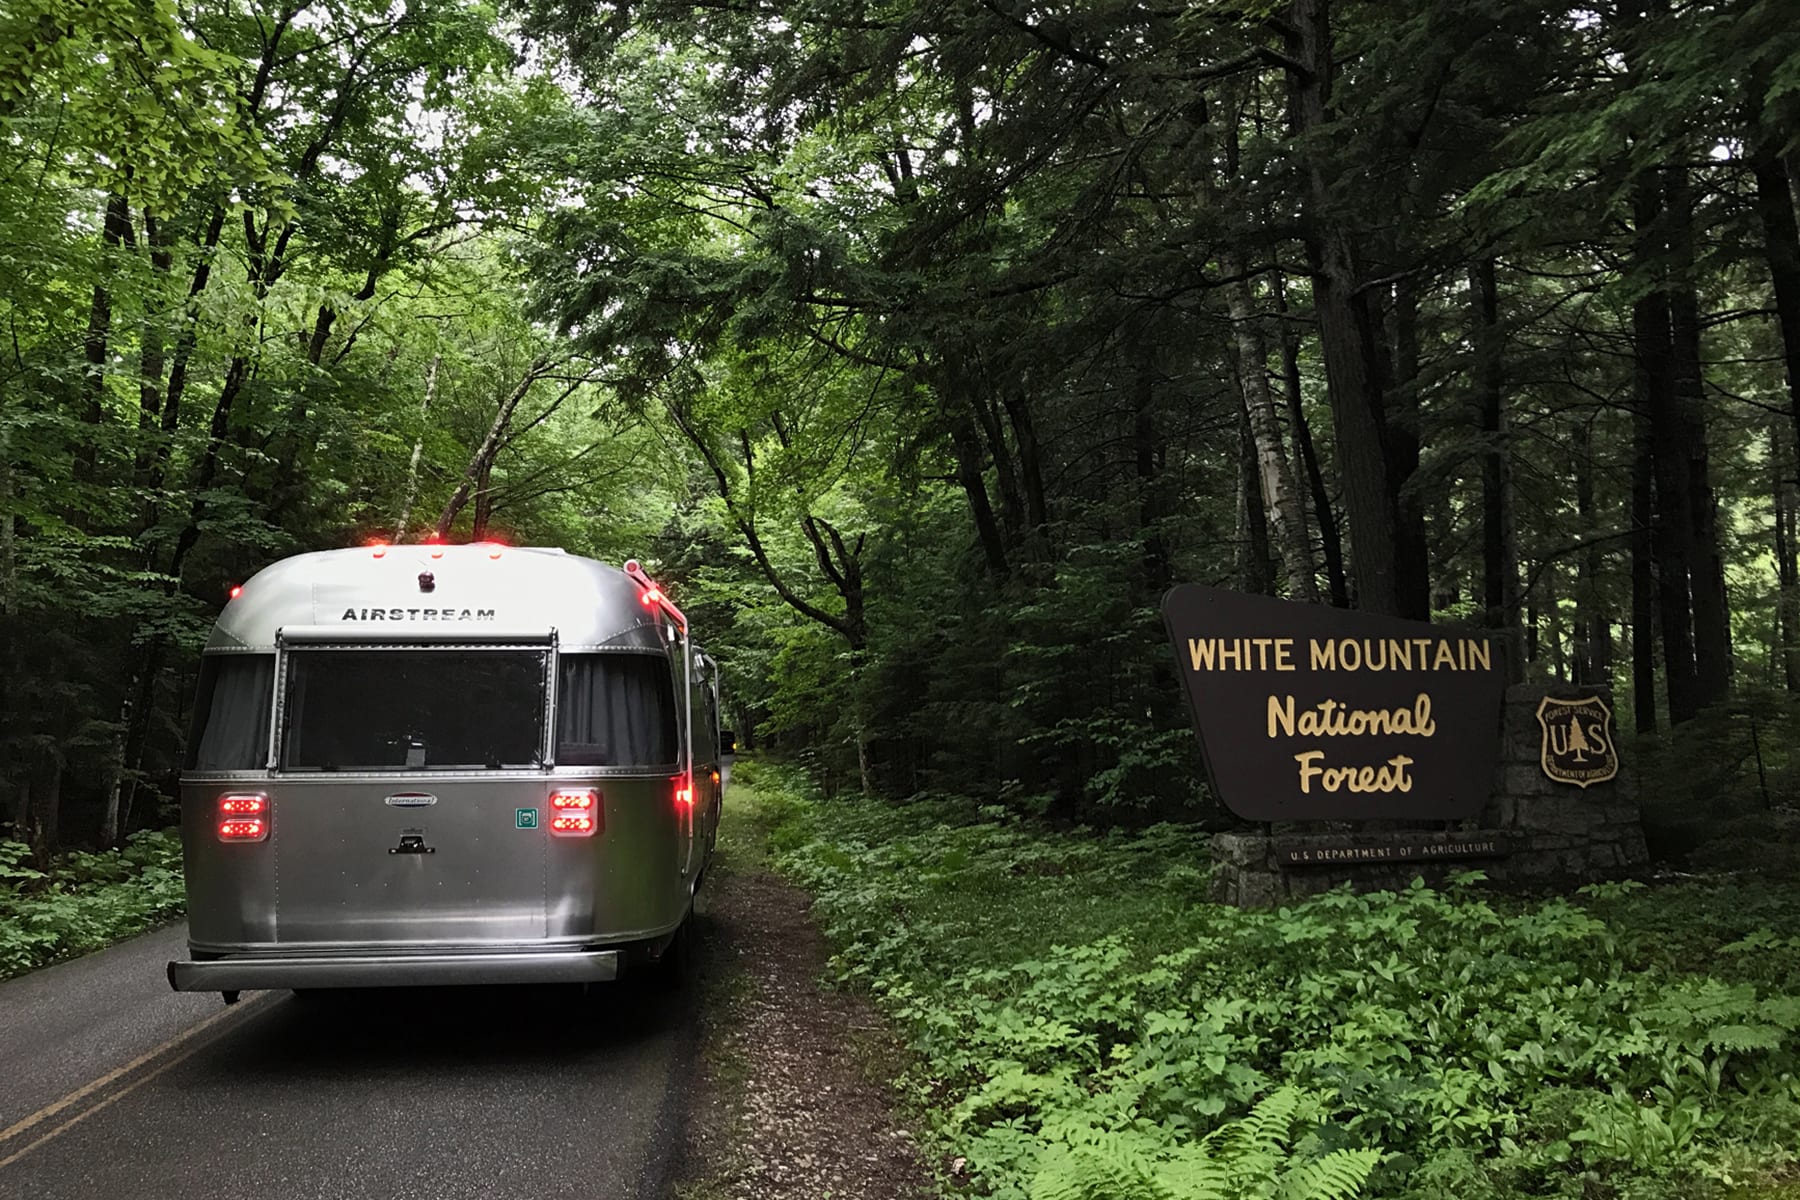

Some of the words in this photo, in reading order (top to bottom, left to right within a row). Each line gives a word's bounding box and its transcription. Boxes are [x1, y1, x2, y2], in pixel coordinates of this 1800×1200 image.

[341, 608, 495, 621] AIRSTREAM
[1188, 638, 1296, 671] WHITE
[1310, 638, 1492, 671] MOUNTAIN
[1267, 693, 1436, 738] National
[1294, 750, 1414, 794] Forest
[1316, 847, 1392, 860] DEPARTMENT
[1399, 847, 1414, 857] OF
[1422, 842, 1496, 856] AGRICULTURE
